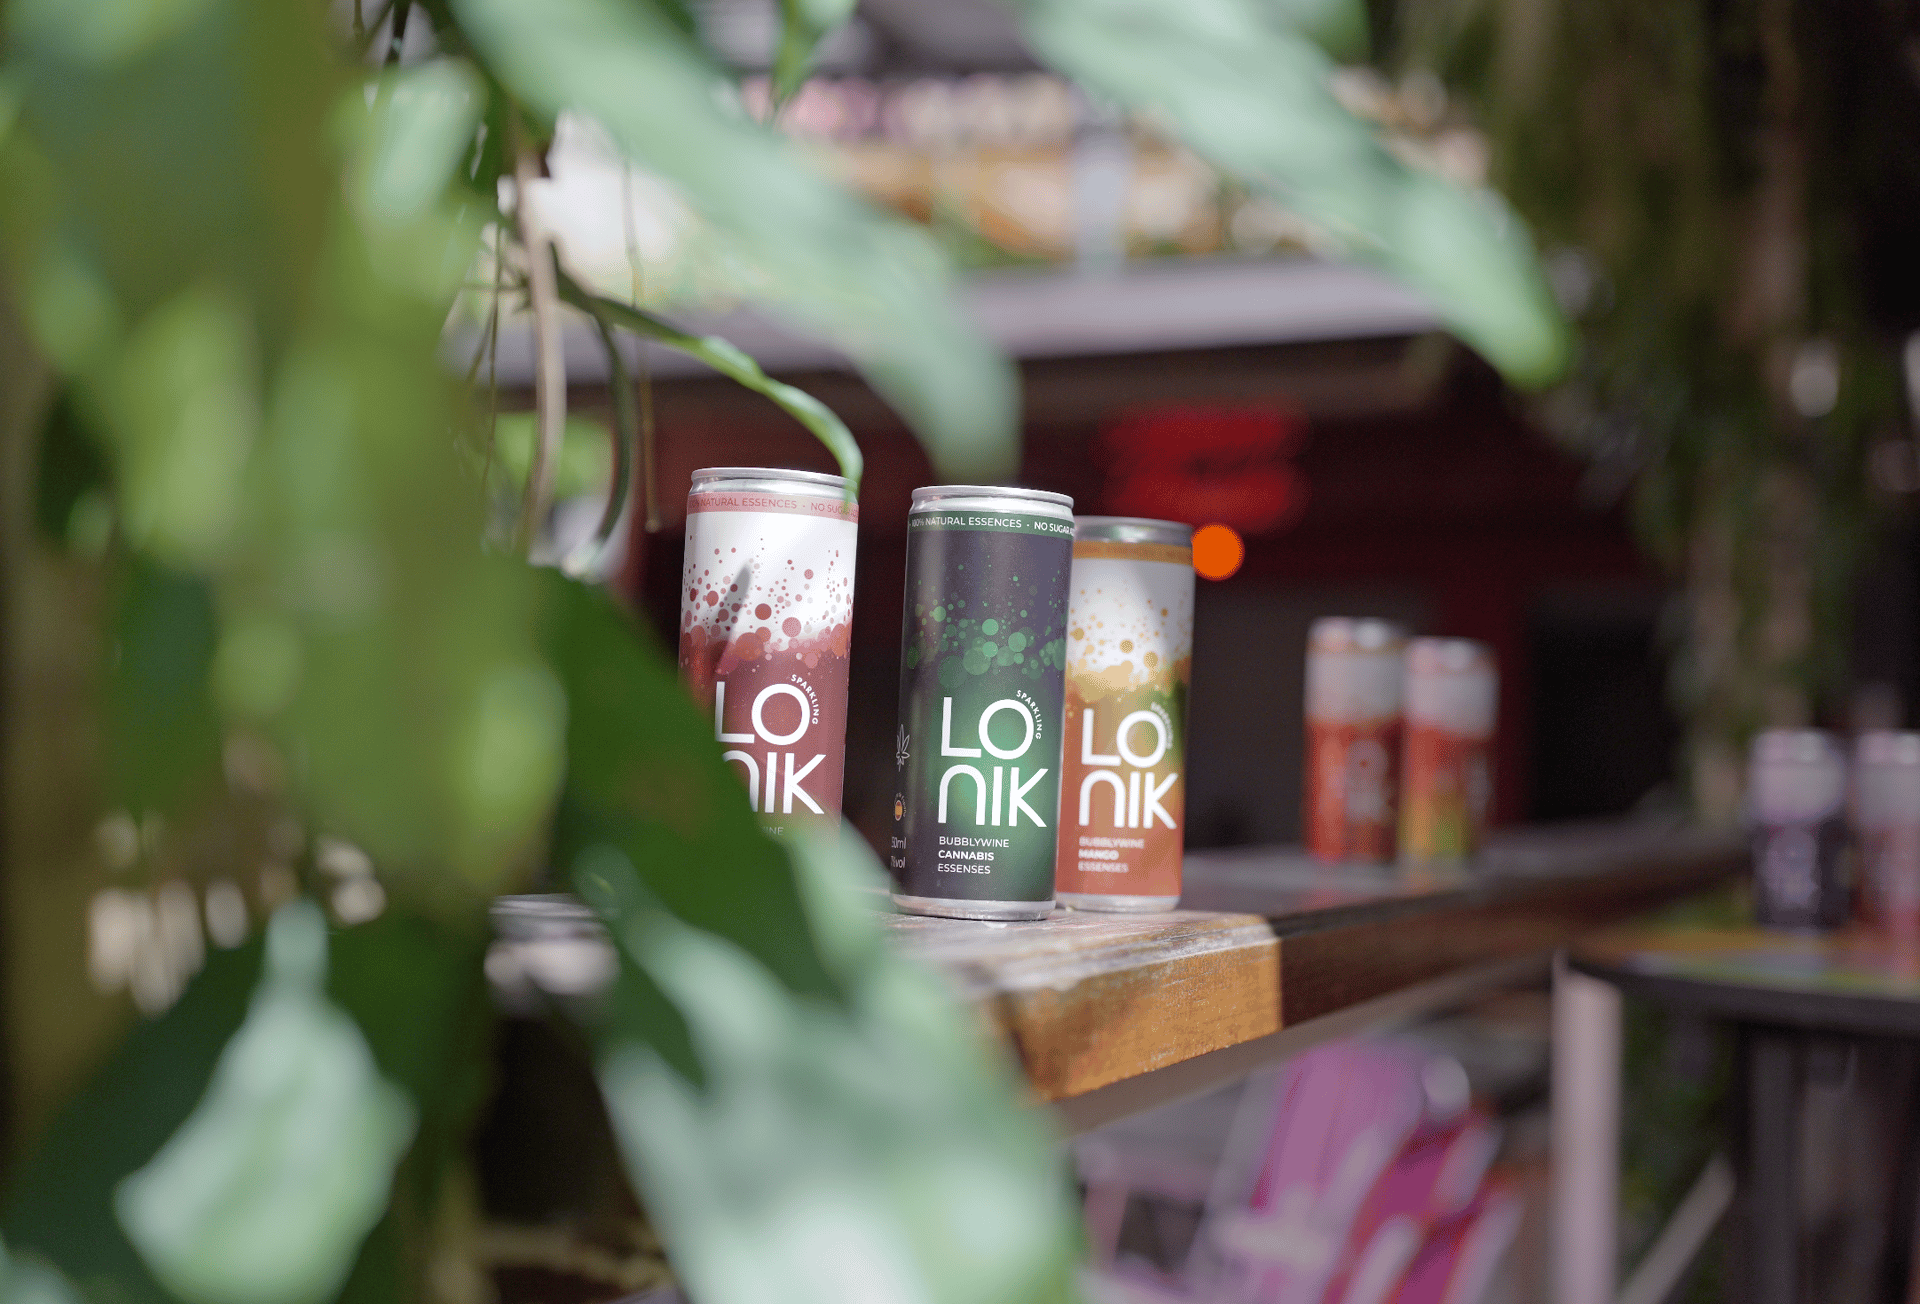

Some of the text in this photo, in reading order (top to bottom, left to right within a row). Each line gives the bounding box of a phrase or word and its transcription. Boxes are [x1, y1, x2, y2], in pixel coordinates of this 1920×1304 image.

[700, 497, 740, 507] NATURAL
[742, 498, 798, 509] ESSENCES
[810, 502, 826, 512] NO
[925, 516, 966, 526] NATURAL
[968, 517, 1022, 528] ESSENCES
[1034, 521, 1049, 531] NO
[790, 674, 820, 725] SPARKLING
[715, 681, 810, 746] LO
[1016, 689, 1043, 740] SPARKLING
[941, 696, 1035, 760] LO
[1081, 708, 1168, 768] LO
[939, 836, 1010, 848] BUBBLYWINE
[938, 850, 995, 861] CANNABIS
[1078, 849, 1119, 860] MANGO
[937, 863, 991, 874] ESSENSES
